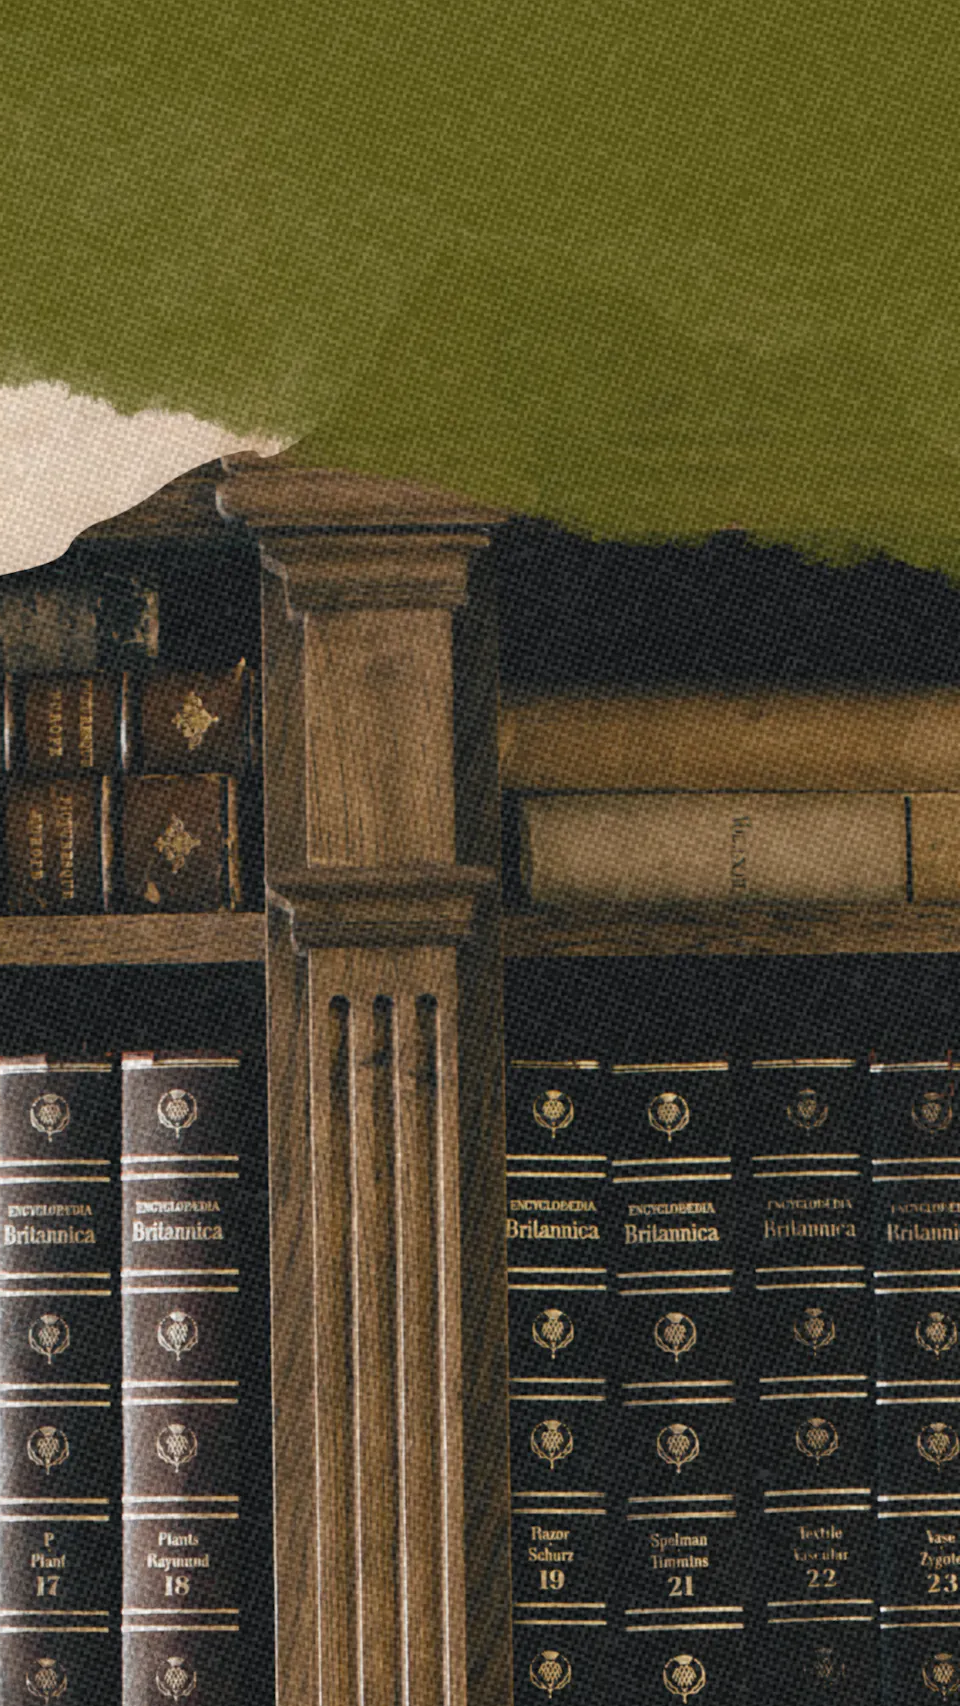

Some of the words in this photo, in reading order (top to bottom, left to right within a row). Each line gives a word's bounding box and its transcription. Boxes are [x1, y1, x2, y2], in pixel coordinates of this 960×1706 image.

[2, 1223, 97, 1247] Britannica
[132, 1219, 225, 1242] Britannica
[505, 1218, 601, 1242] Britannica
[624, 1222, 721, 1246] Britannica
[763, 1219, 857, 1239] Britannica
[43, 1531, 55, 1548] P
[157, 1531, 200, 1547] Plants
[530, 1525, 570, 1541] Razor
[649, 1532, 709, 1551] Spelman
[798, 1524, 844, 1541] Textile
[30, 1552, 67, 1570] Plant
[527, 1546, 575, 1563] Schurz
[650, 1554, 710, 1569] Timmins
[35, 1575, 60, 1598] 17
[163, 1575, 191, 1598] 18
[538, 1568, 567, 1591] 19
[667, 1575, 695, 1598] 21
[805, 1567, 838, 1589] 22
[926, 1572, 959, 1594] 23
